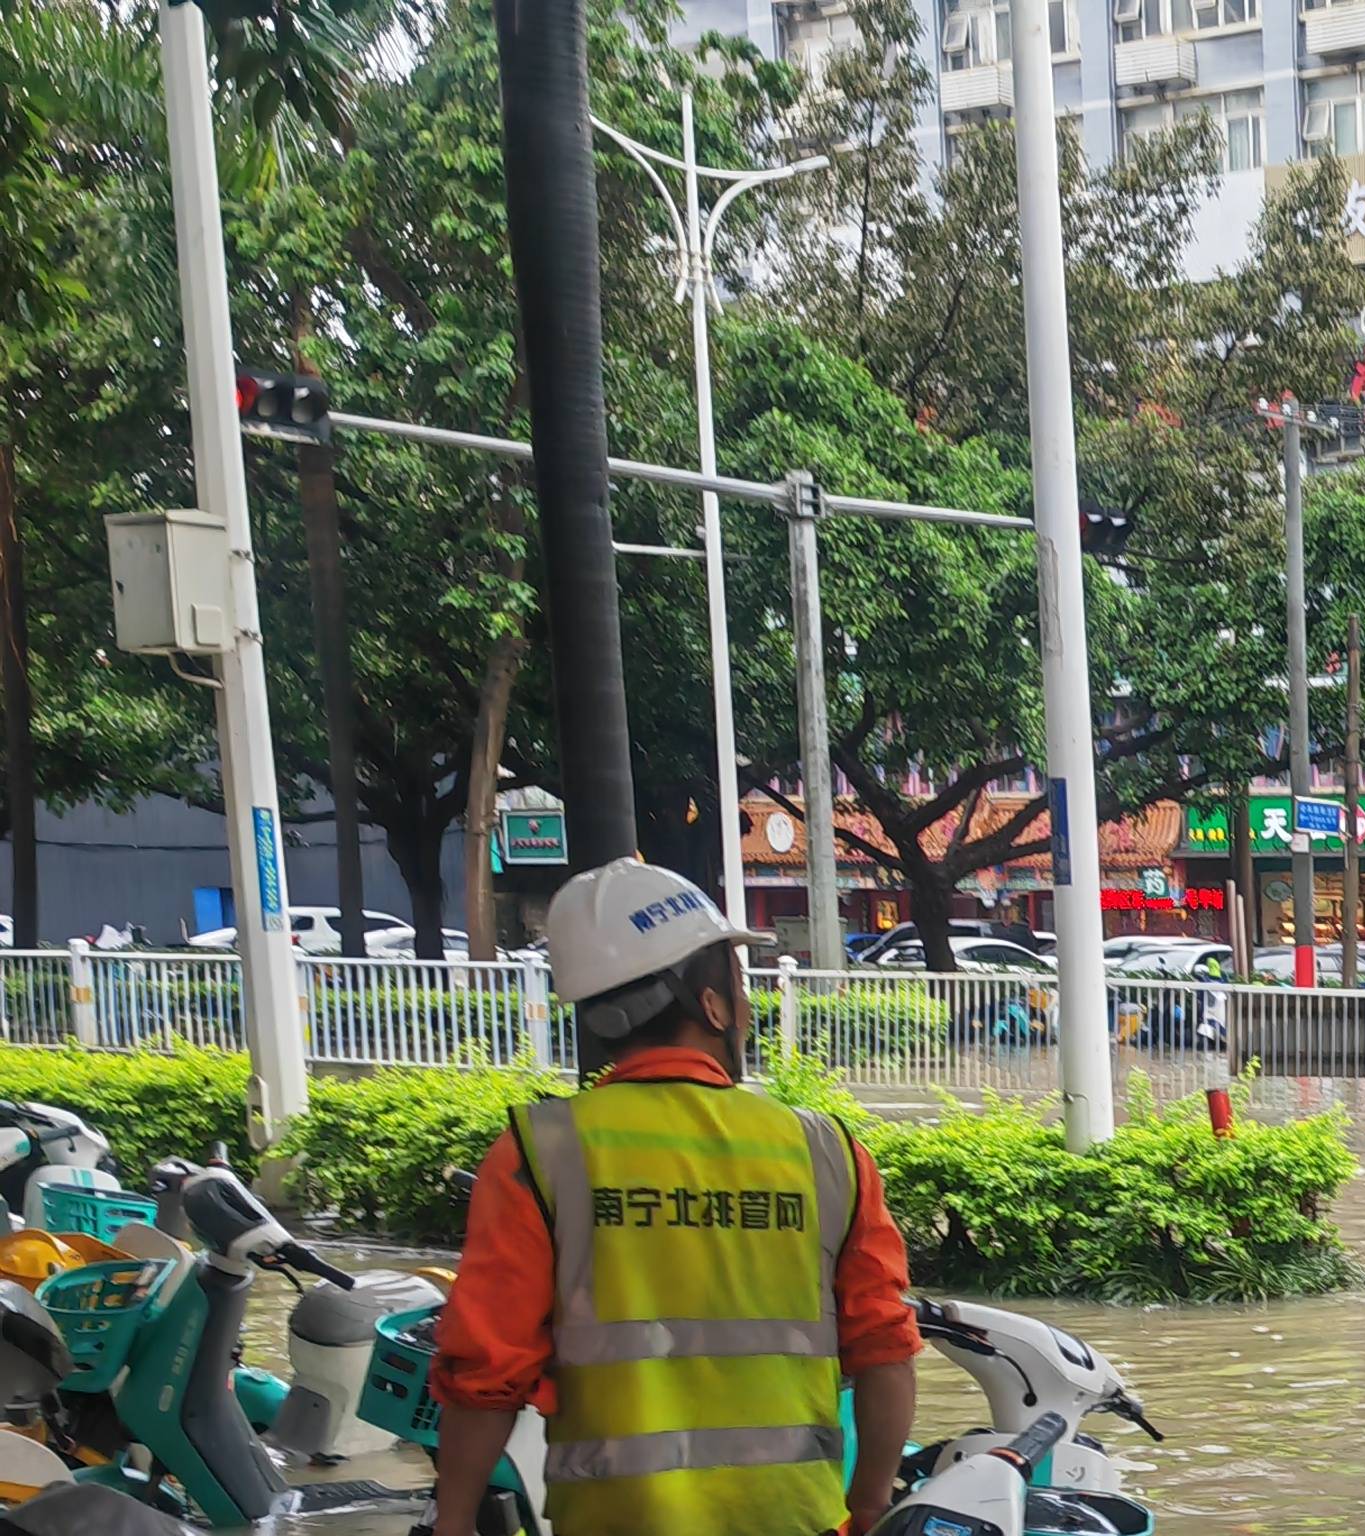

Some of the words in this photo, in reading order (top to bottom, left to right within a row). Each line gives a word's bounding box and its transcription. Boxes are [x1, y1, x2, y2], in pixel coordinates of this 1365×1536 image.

[594, 1185, 805, 1233] 南宁北排管网
